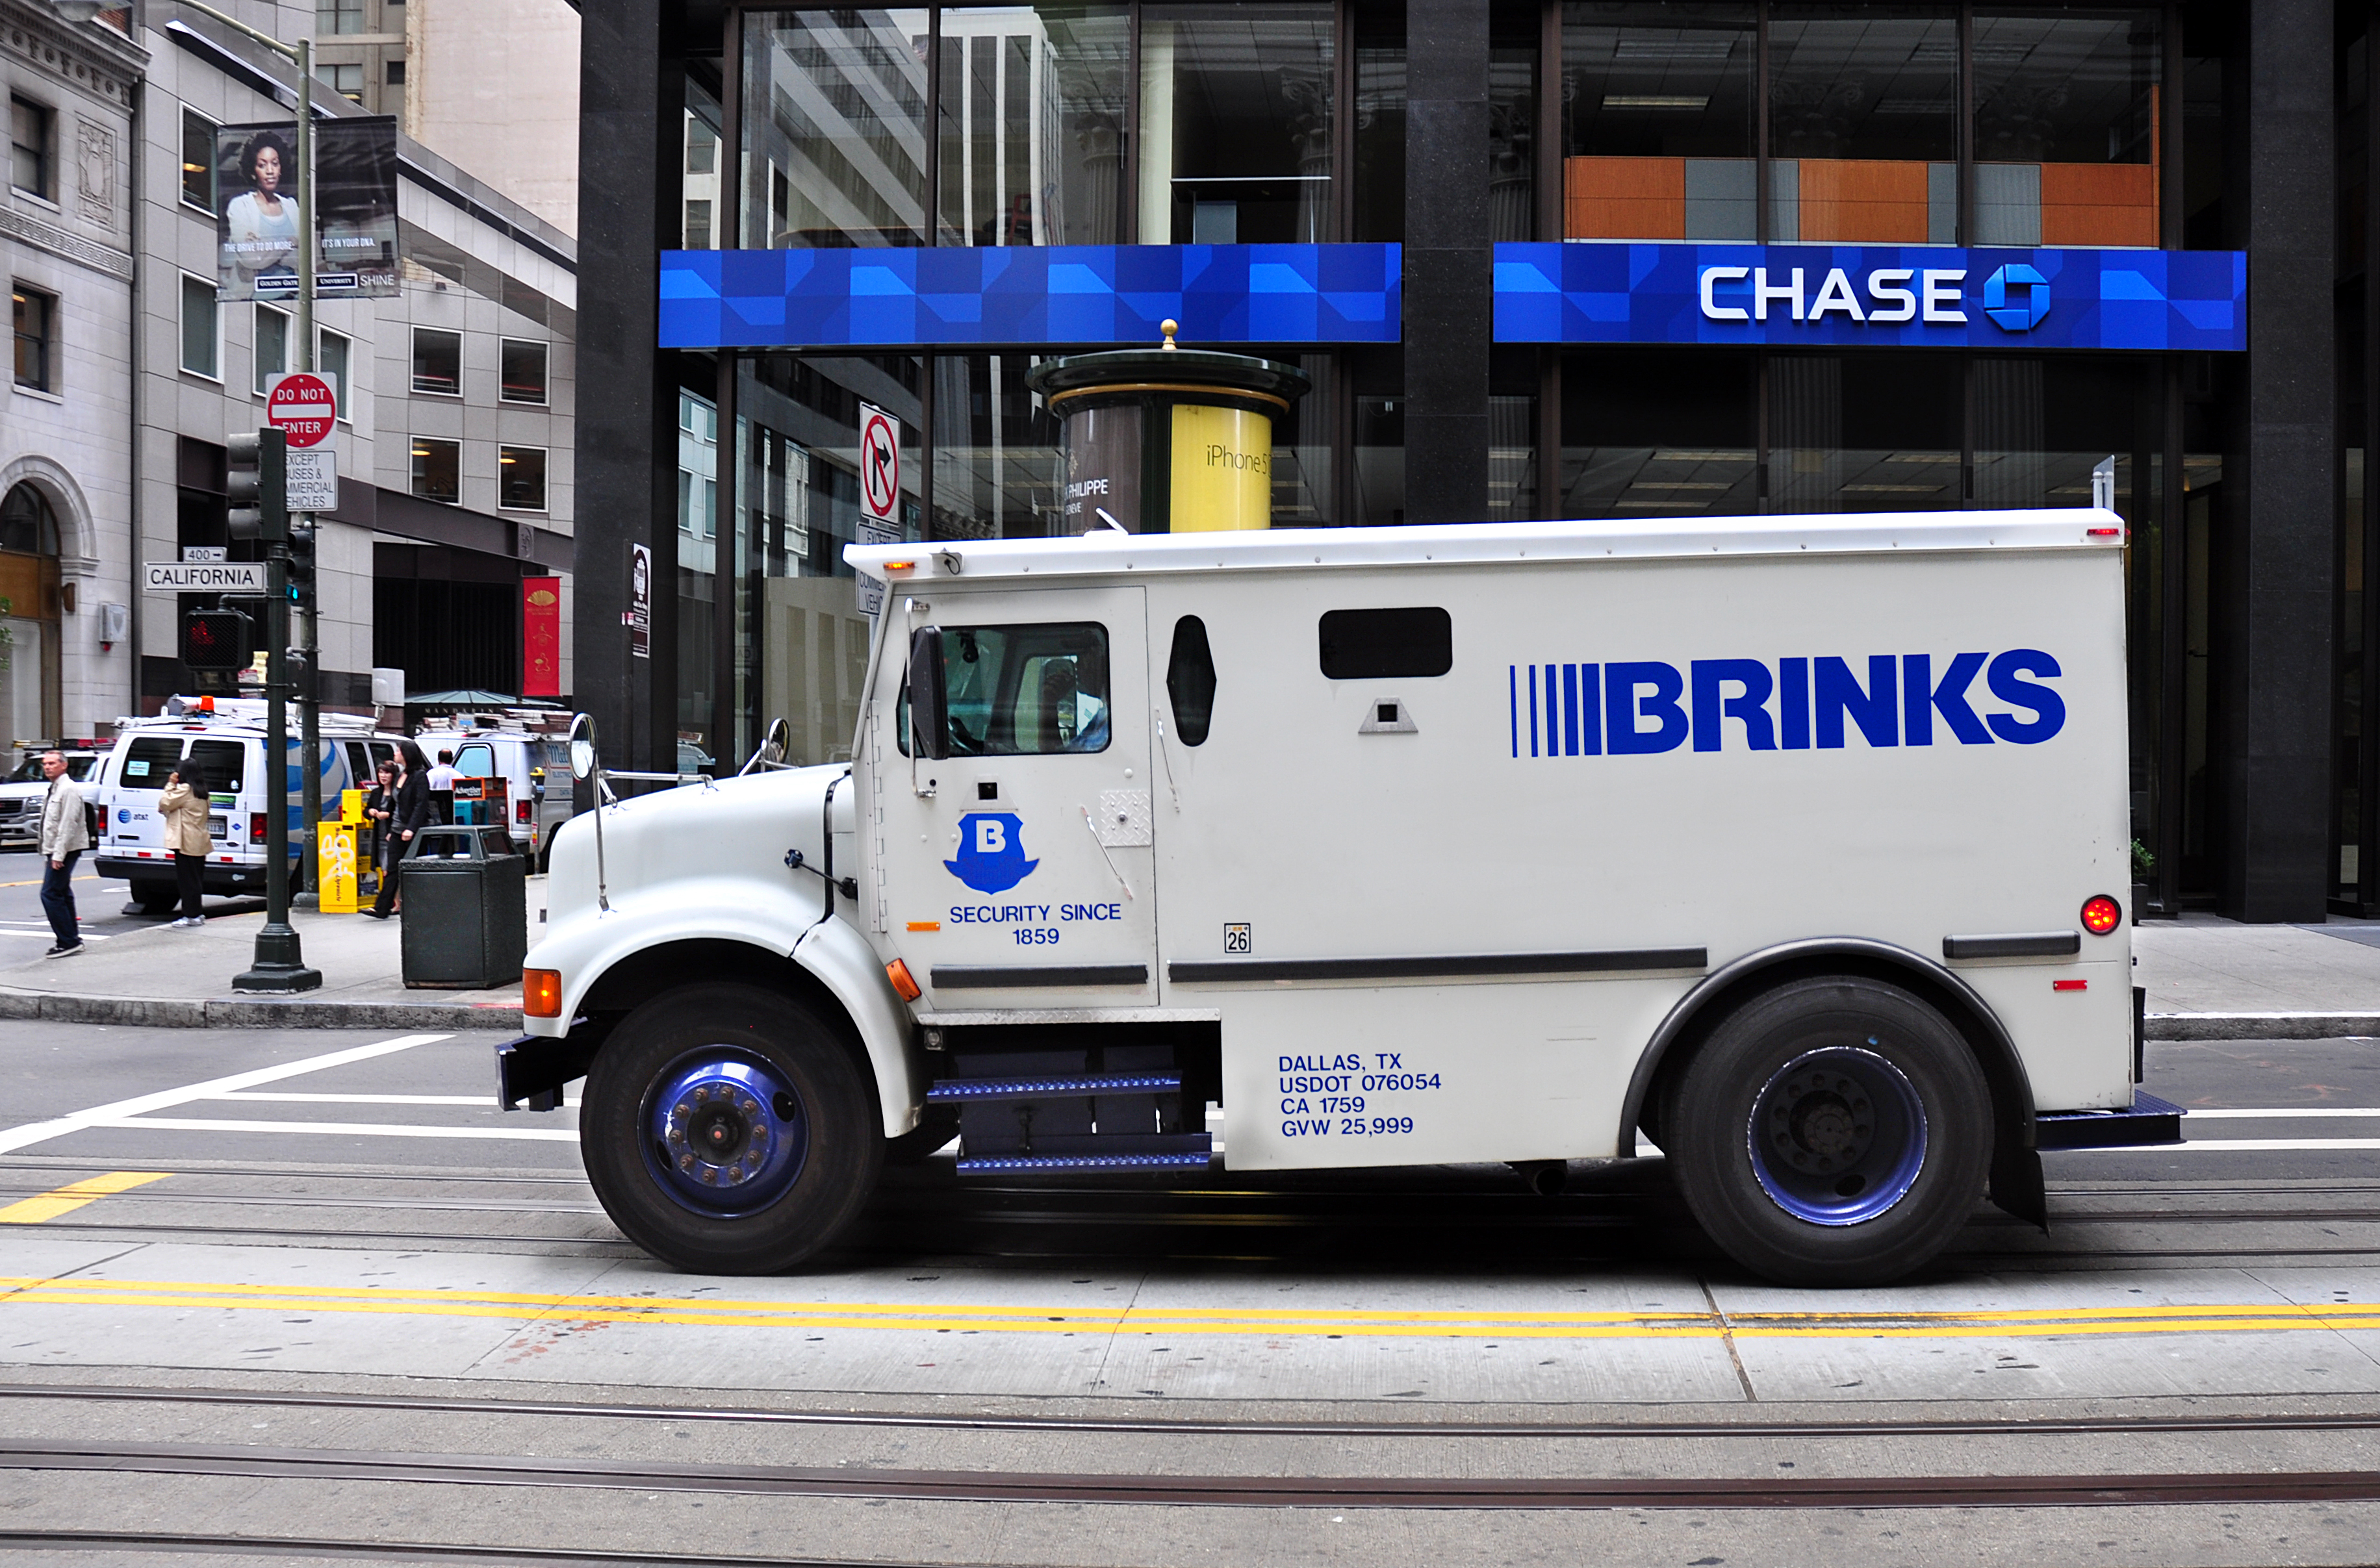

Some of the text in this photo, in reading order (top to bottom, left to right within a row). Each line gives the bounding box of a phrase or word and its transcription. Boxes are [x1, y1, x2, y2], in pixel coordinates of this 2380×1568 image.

[360, 274, 395, 286] SHINE
[1700, 266, 1968, 322] CHASE
[277, 388, 326, 401] DO NOT
[283, 422, 321, 434] ENTER
[1207, 445, 1260, 473] iPhone
[286, 468, 322, 480] USES &
[1069, 479, 1108, 499] PHILIPPE
[286, 496, 326, 507] EHICLES
[188, 550, 210, 560] 400
[150, 568, 255, 585] CALIFORNIA
[1605, 648, 2066, 755] BRINKS
[976, 819, 1006, 853] B
[950, 904, 1121, 923] SECURITY SINCE
[1012, 929, 1060, 944] 1859
[1228, 931, 1248, 950] 26
[1279, 1053, 1402, 1072] DALLAS, TX
[1280, 1073, 1442, 1093] USDOT 076054
[1281, 1098, 1310, 1115] CA
[1319, 1096, 1365, 1113] 1759
[1281, 1117, 1413, 1138] GVW 25,999
